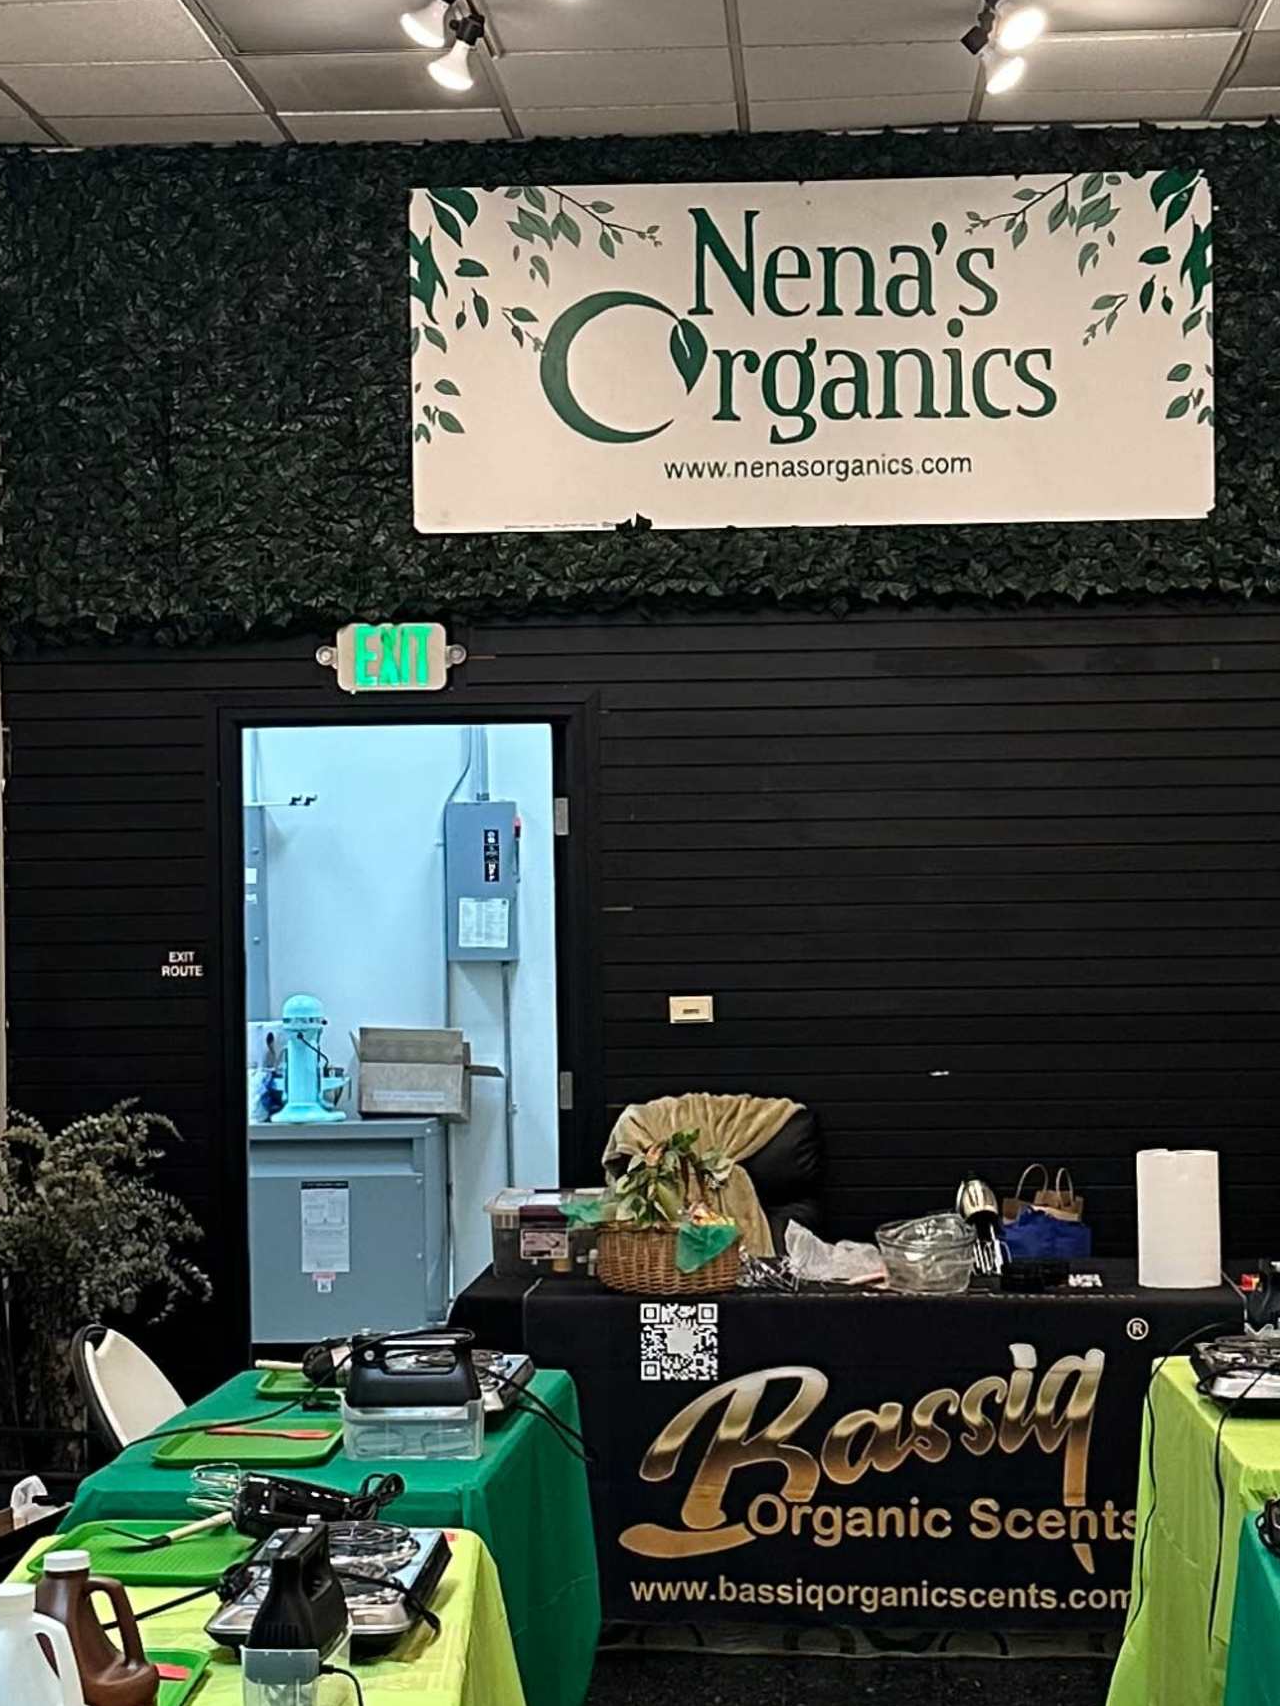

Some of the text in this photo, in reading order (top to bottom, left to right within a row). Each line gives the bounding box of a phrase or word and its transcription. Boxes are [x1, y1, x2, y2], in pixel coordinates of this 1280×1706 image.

[687, 207, 998, 318] Nena's
[540, 290, 1058, 445] Organics
[663, 453, 973, 482] www.nenasorganics.com
[353, 624, 433, 686] EXIT
[161, 964, 204, 977] ROUTE
[168, 951, 196, 963] EXIT
[619, 1343, 1106, 1574] Bassiq
[748, 1495, 1136, 1547] Organic Scents
[630, 1576, 1131, 1613] www.bassiqorganicscents.com
